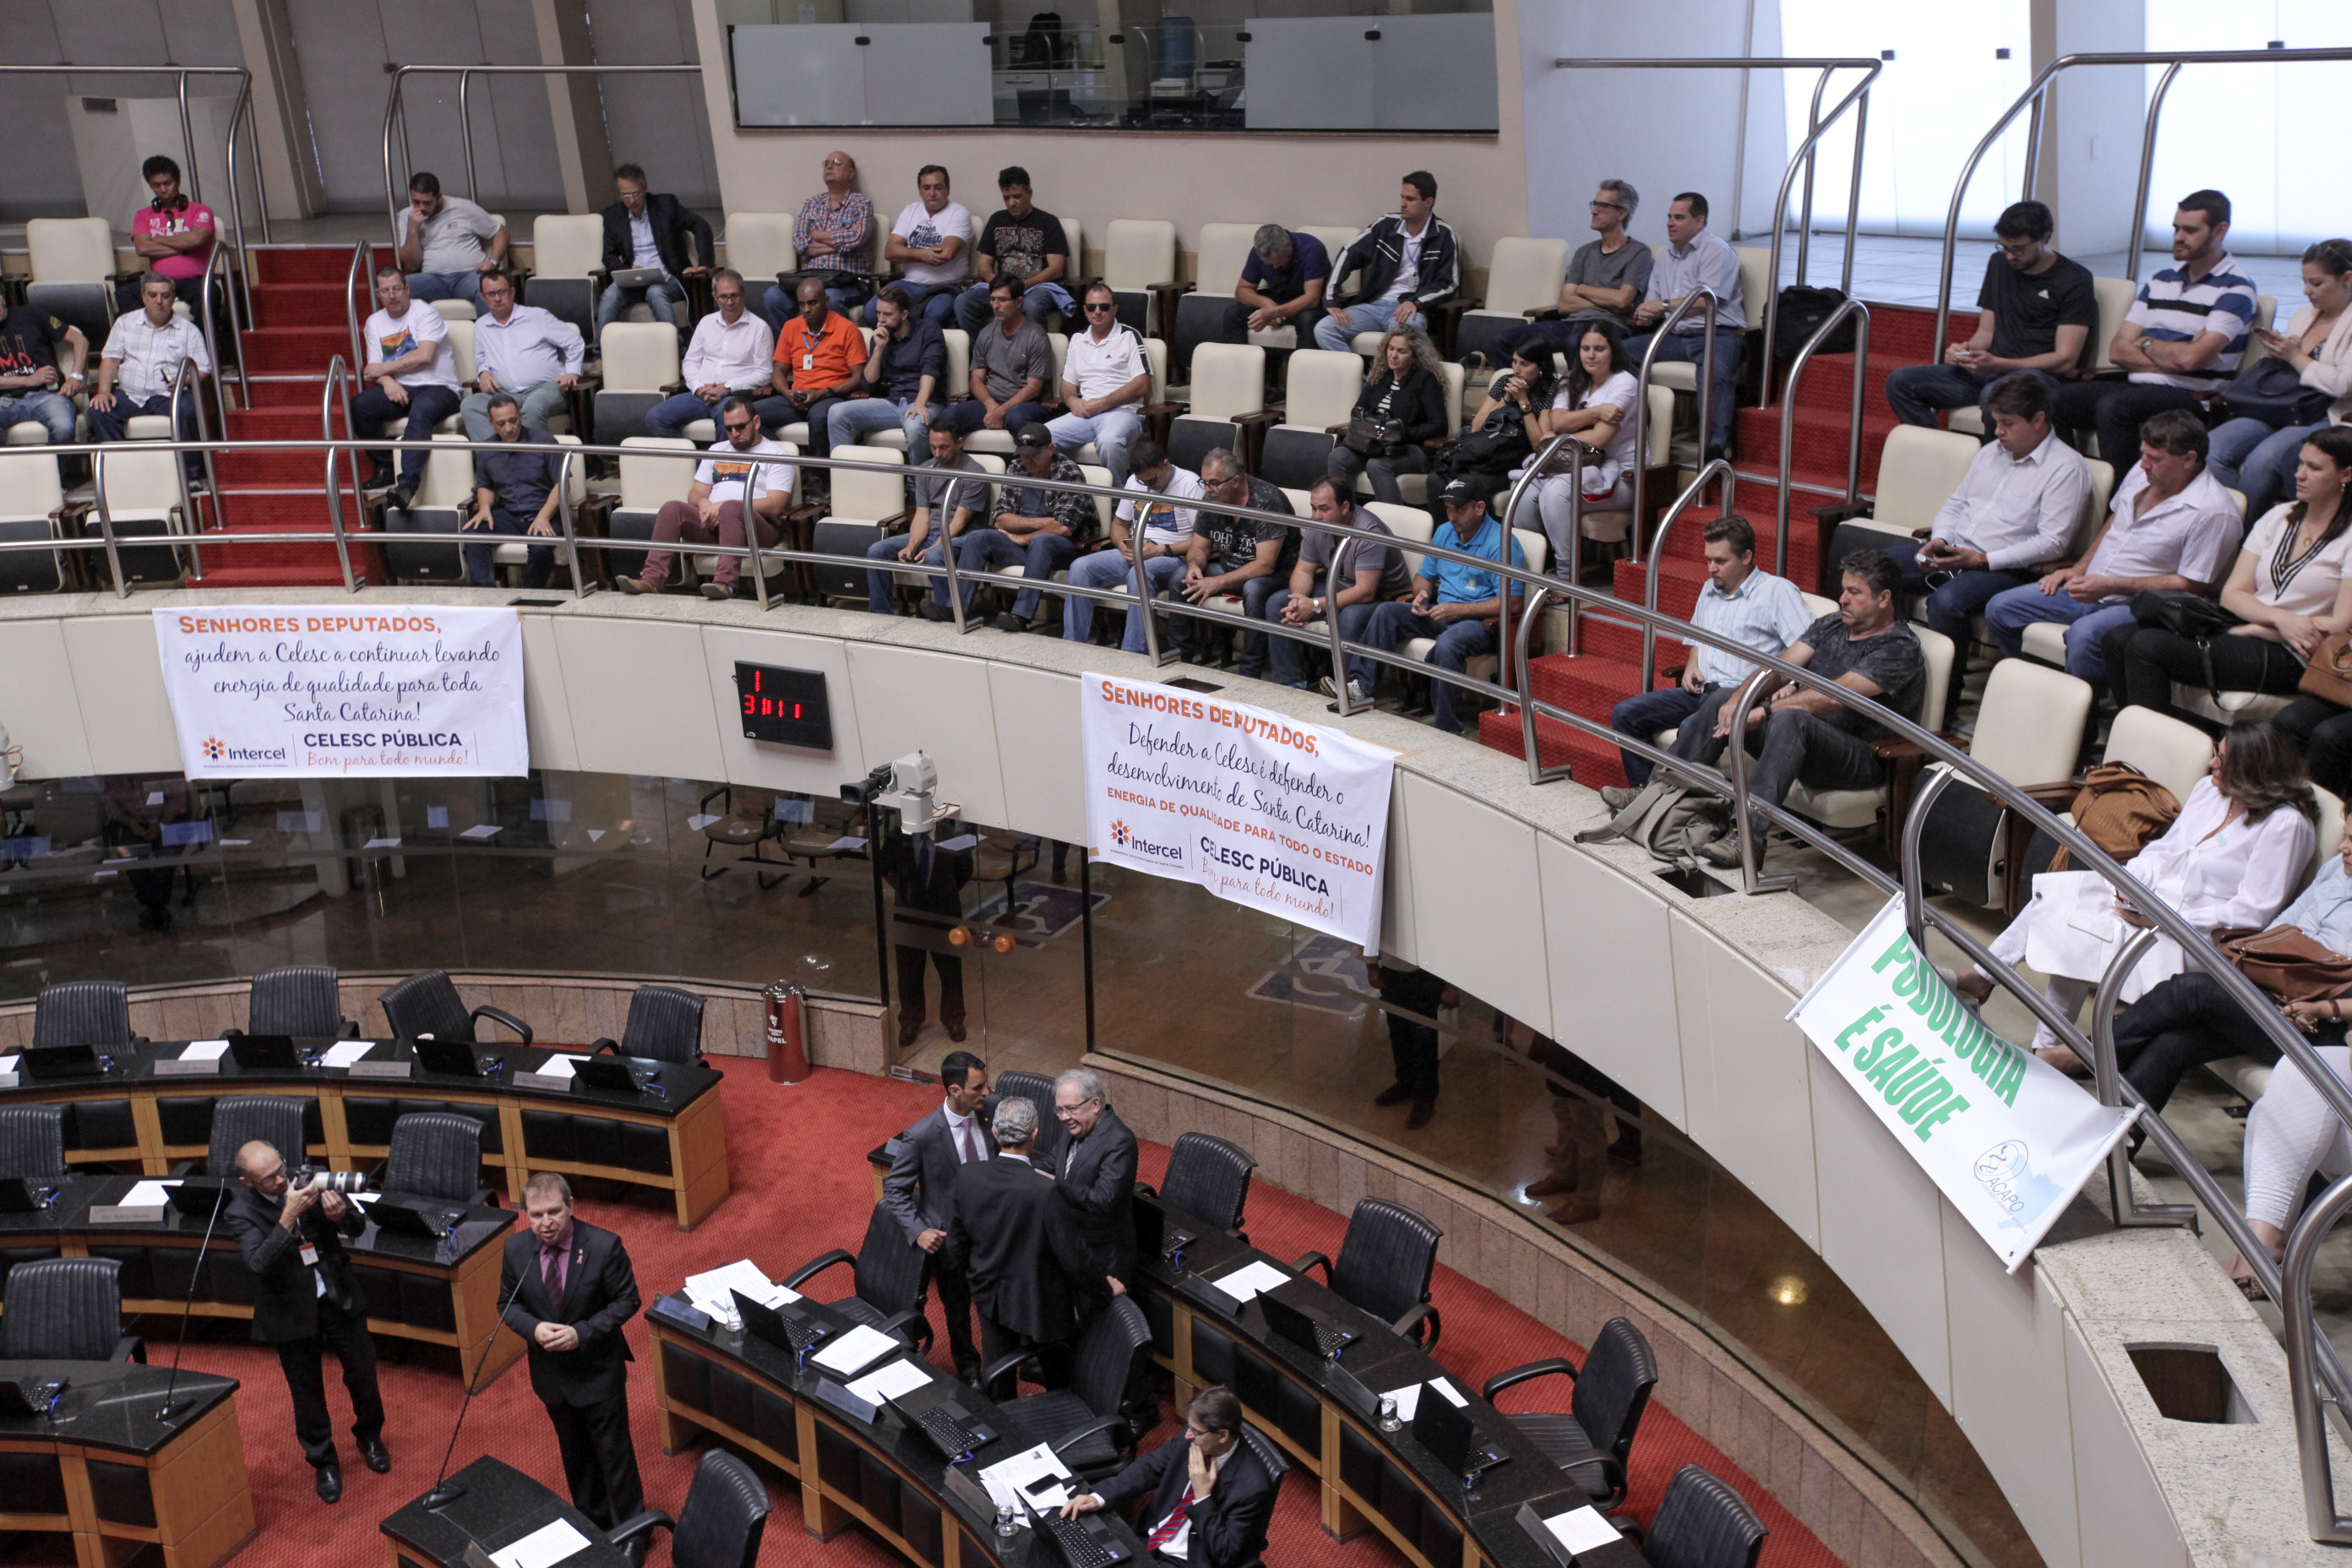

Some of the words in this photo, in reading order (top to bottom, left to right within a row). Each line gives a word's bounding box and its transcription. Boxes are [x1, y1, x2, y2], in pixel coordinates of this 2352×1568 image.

[179, 616, 299, 634] SENHORES
[307, 617, 442, 634] DEPUTADOS,
[184, 640, 254, 672] ajudem
[259, 649, 271, 662] a
[276, 640, 331, 663] Celesc
[335, 649, 346, 662] a
[350, 641, 432, 662] continuar
[434, 640, 500, 662] levando
[214, 672, 278, 700] energia
[282, 671, 303, 692] de
[307, 671, 394, 703] qualidade
[397, 678, 439, 703] para
[442, 671, 482, 692] toda
[283, 703, 335, 722] Santa
[340, 702, 420, 722] Catarina!
[1101, 681, 1204, 719] SENHORES
[1210, 705, 1319, 758] DEPUTADOS,
[229, 747, 286, 760] Intercel
[303, 733, 377, 747] CELESC
[383, 729, 462, 747] PÚBLICA
[308, 751, 340, 765] Bom
[344, 754, 378, 774] para
[380, 750, 410, 765] todo
[415, 749, 469, 765] mundo!
[1128, 721, 1198, 759] Defender
[1201, 746, 1211, 760] a
[1215, 742, 1259, 774] Celesc
[1259, 760, 1266, 777] é
[1269, 760, 1333, 801] defender
[1337, 792, 1344, 804] o
[1108, 751, 1222, 801] desenvolvimento
[1226, 781, 1248, 808] de
[1250, 789, 1293, 824] Santa
[1295, 805, 1371, 848] Catarina!
[1108, 787, 1156, 809] ENERGIA
[1160, 799, 1176, 814] DE
[1179, 804, 1240, 832] QUALIDADE
[1244, 823, 1277, 841] PARA
[1279, 833, 1309, 856] TODO
[1312, 847, 1322, 859] O
[1325, 851, 1373, 876] ESTADO
[1132, 836, 1182, 860] Intercel
[1200, 836, 1255, 871] CELESC
[1260, 856, 1330, 897] PÚBLICA
[1220, 874, 1252, 894] para
[1255, 877, 1282, 902] todo
[1285, 893, 1334, 920] mundo!
[1870, 928, 2028, 1108] PODOLOGIA
[767, 1035, 787, 1044] PAPEL
[1853, 1026, 1972, 1143] SAÚDE
[1985, 1178, 2024, 1211] ACAPO
